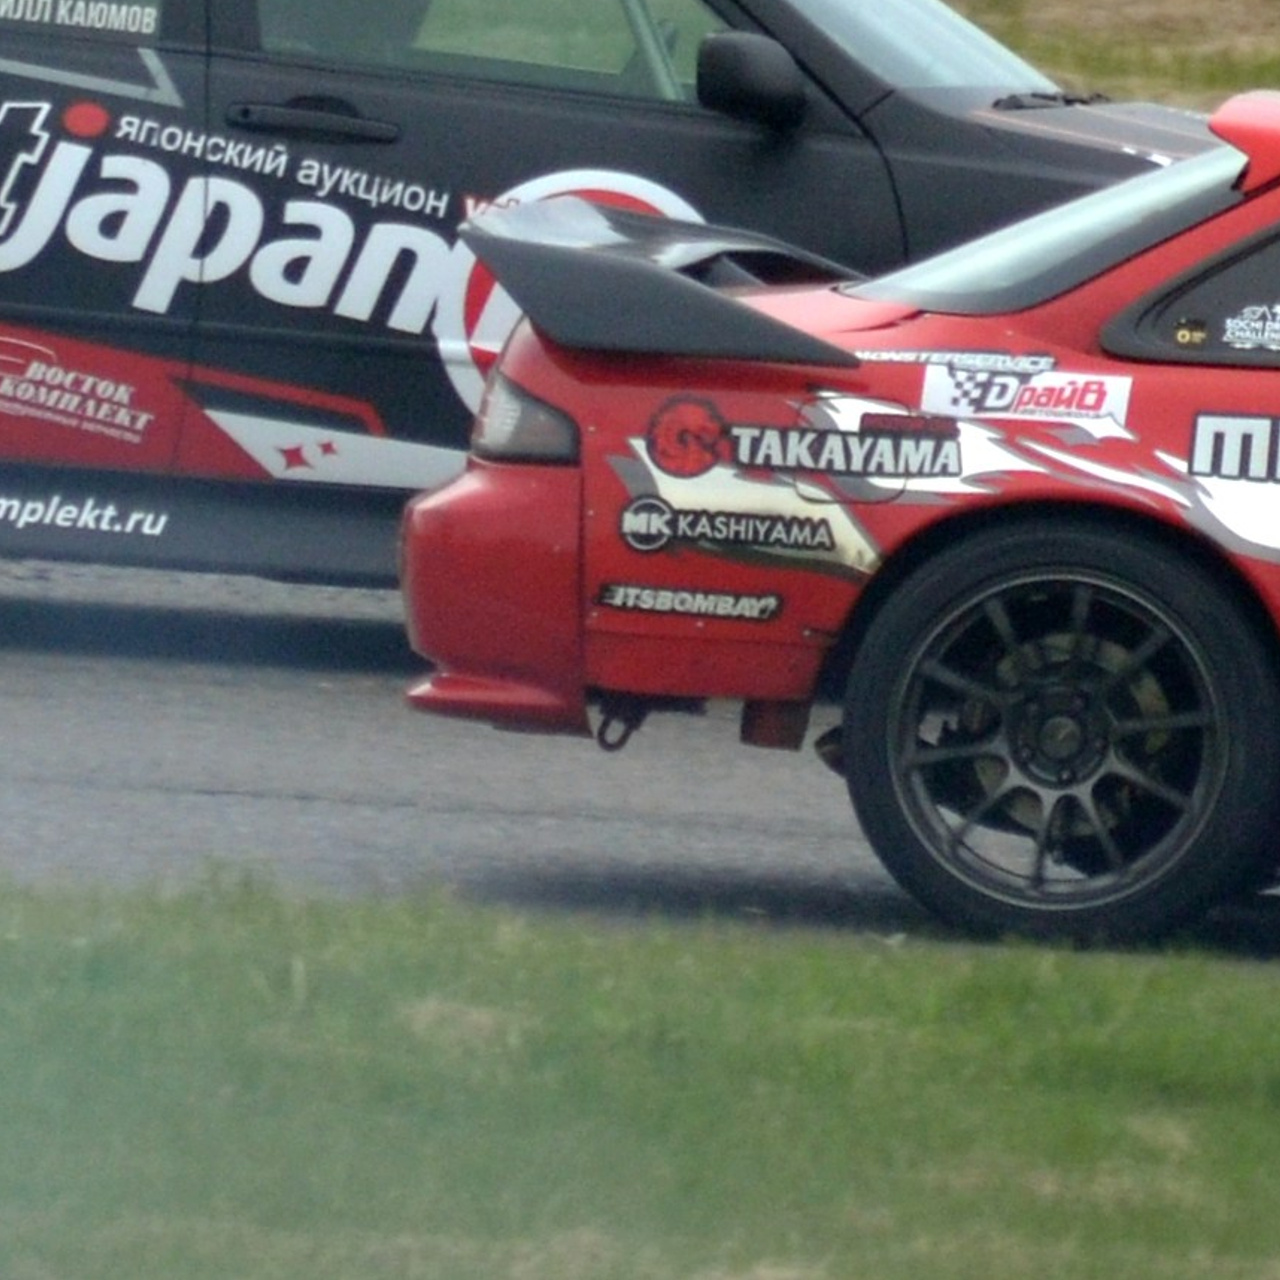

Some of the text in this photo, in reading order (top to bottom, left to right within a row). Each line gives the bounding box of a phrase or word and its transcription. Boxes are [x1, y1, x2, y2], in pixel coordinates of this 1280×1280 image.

[116, 116, 288, 179] японский
[298, 156, 450, 219] аукцион
[0, 377, 155, 431] КОМПЛЕКТ
[26, 360, 135, 406] ВОСТОК
[731, 426, 962, 475] TAKAYAMA
[677, 516, 833, 549] KASHIYAMA
